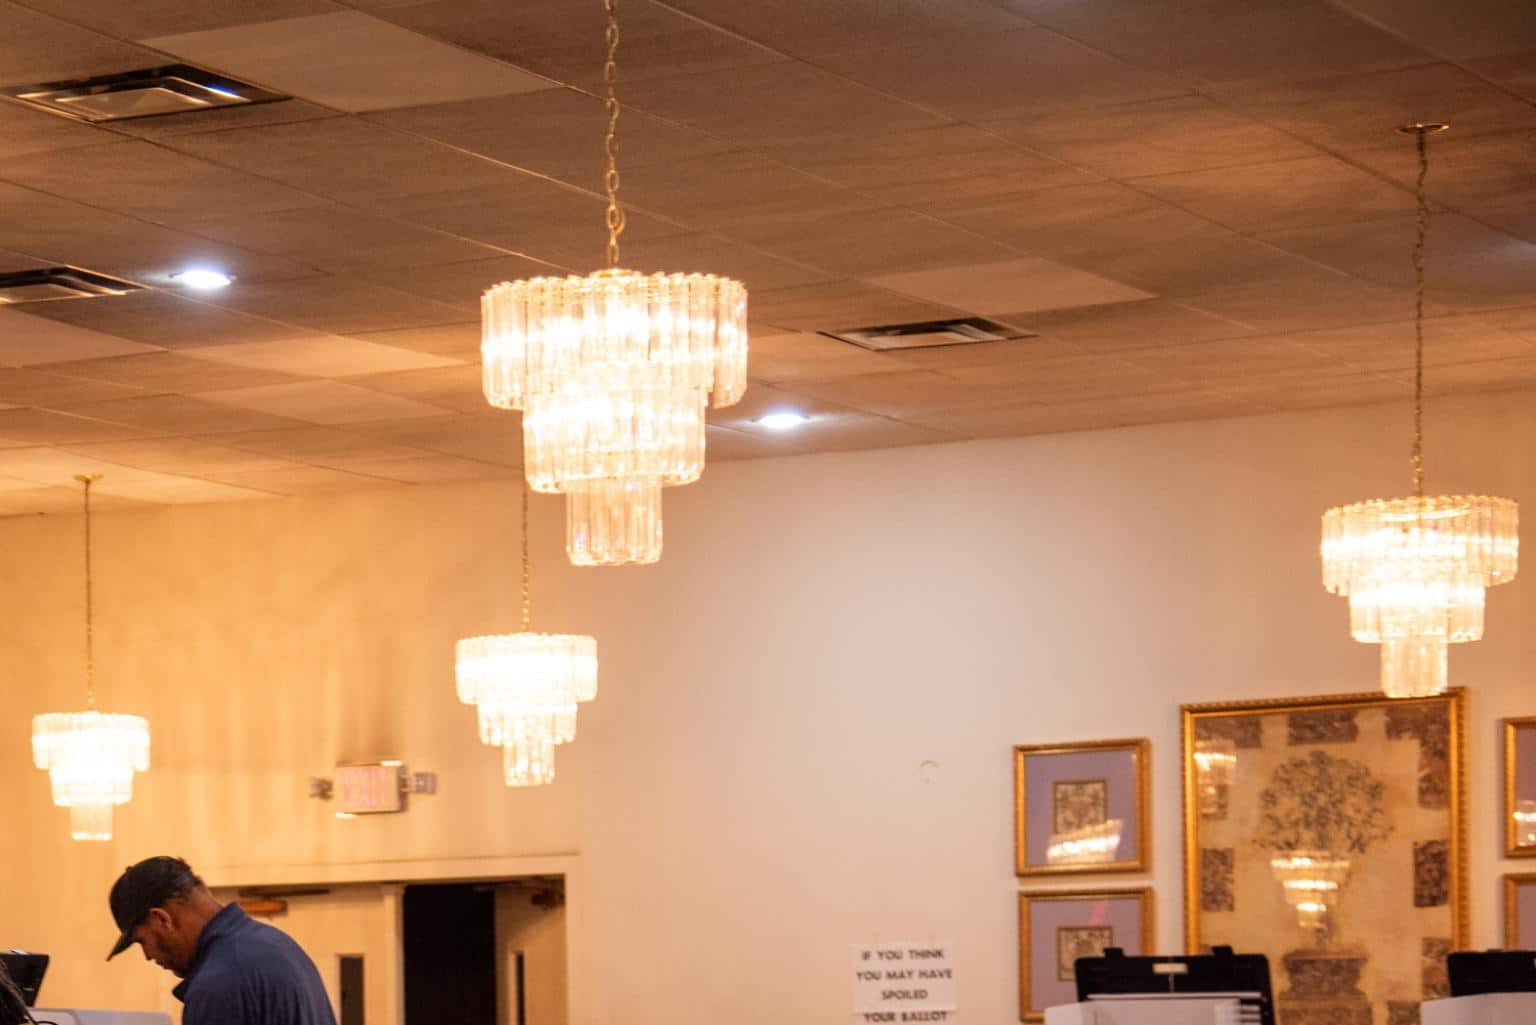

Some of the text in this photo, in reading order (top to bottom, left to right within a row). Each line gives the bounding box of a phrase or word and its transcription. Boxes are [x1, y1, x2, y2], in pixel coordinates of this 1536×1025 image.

[878, 950, 903, 960] YOU
[908, 949, 944, 959] THINK
[856, 968, 952, 980] YOU MAY HAVE
[881, 989, 928, 1000] SPOILED
[864, 1010, 947, 1022] YOUR BALLOT
